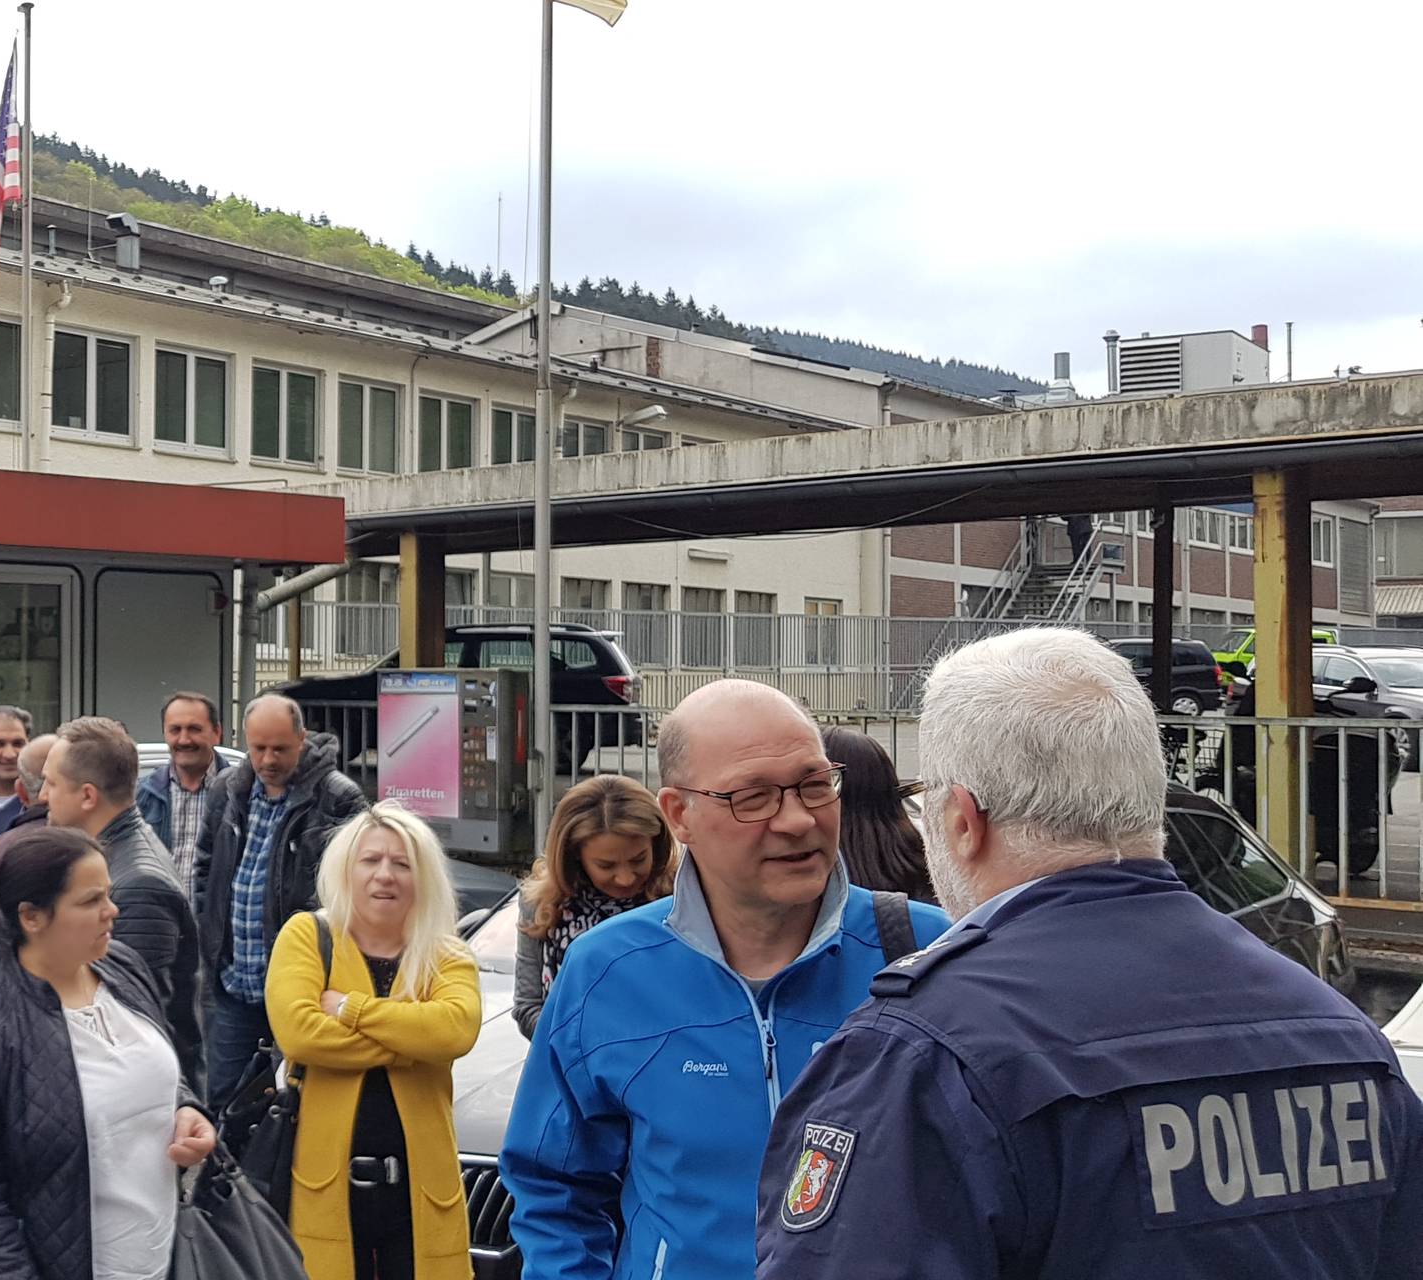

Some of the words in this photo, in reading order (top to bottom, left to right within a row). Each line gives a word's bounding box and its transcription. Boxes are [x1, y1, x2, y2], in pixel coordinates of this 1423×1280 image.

[385, 785, 445, 800] Zigaretten
[682, 1060, 728, 1075] Bergans
[805, 1129, 849, 1154] POLIZEI
[1141, 1079, 1387, 1214] POLIZEI
